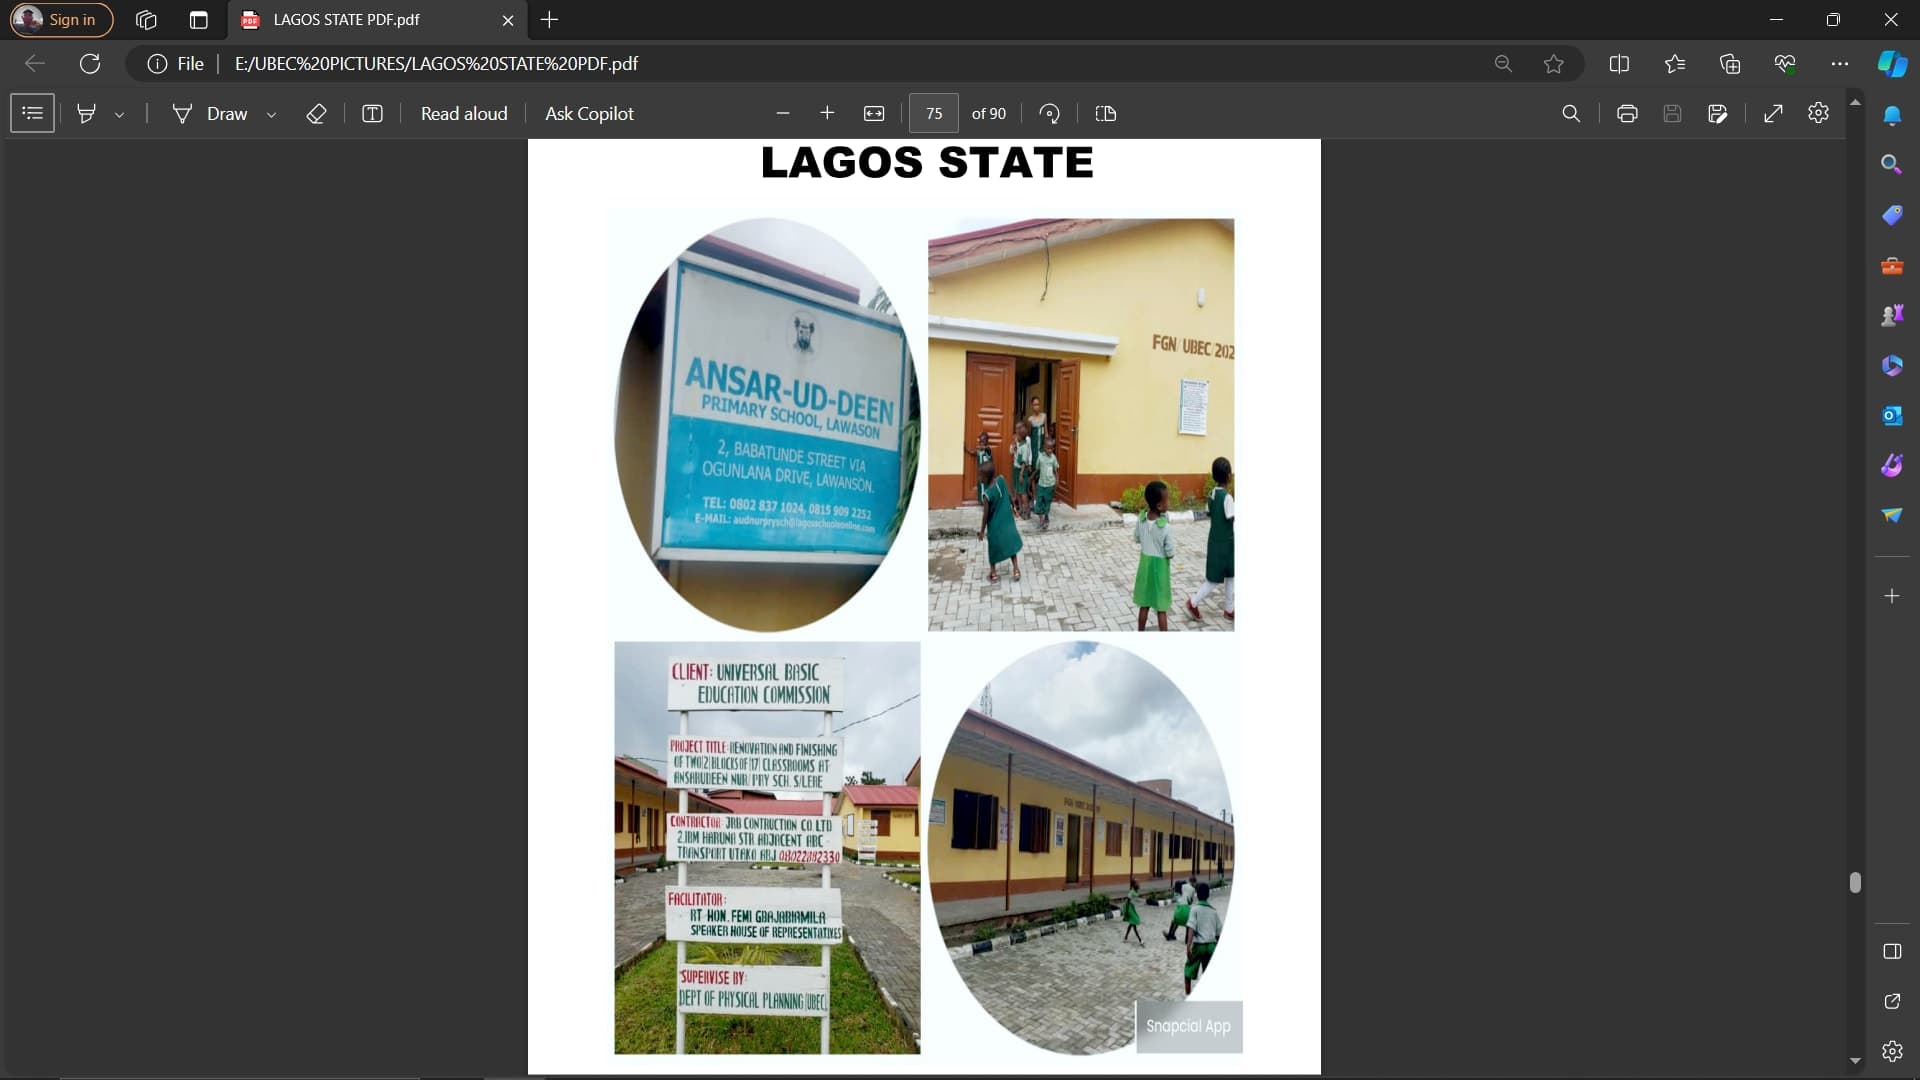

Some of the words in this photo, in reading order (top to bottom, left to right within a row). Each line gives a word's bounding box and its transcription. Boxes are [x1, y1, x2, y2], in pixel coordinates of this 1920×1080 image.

[49, 12, 77, 28] Sign
[80, 12, 96, 26] in
[273, 13, 320, 27] LAGOS
[323, 13, 363, 27] STATE
[366, 13, 421, 30] PDF.pdf
[177, 56, 205, 72] File
[235, 56, 640, 75] E:/UBEC%20PICTURES/LAGOS%20STATE%20PDF.pdf
[206, 106, 248, 122] Draw
[421, 106, 456, 121] Read
[458, 106, 509, 121] aloud
[544, 106, 572, 121] Ask
[574, 106, 635, 125] Copilot
[925, 107, 944, 121] 75
[971, 105, 987, 121] of
[988, 106, 1007, 121] 90
[762, 145, 924, 179] LAGOS
[938, 145, 1094, 179] STATE
[685, 356, 894, 427] ANSAR-UD-DEEN
[702, 394, 767, 419] PRIMARY
[770, 405, 823, 432] SCHOOL,
[826, 417, 880, 441] LAWASON
[717, 439, 729, 459] 2,
[734, 441, 804, 465] BABATUNDE
[807, 451, 847, 469] STREET
[849, 457, 866, 473] VIA
[702, 460, 772, 482] OGUNLANA
[775, 469, 813, 488] DRIVE,
[816, 473, 875, 494] LAWANSON.
[703, 496, 727, 510] TEL:
[729, 497, 756, 512] 0802
[758, 498, 777, 513] 837
[695, 513, 732, 525] E-MAIL:
[672, 662, 713, 681] CLIENT:
[716, 663, 780, 682] UNIVERSAL
[784, 663, 820, 682] BASIC
[698, 684, 759, 704] EDUCATION
[763, 684, 831, 705] COMMISSION
[670, 739, 704, 754] PROJECT
[729, 741, 777, 756] RENOVATION
[778, 743, 794, 756] AND
[795, 743, 838, 757] FINISHING
[673, 755, 683, 768] OF
[762, 758, 815, 773] CLASSROOMS
[817, 759, 830, 774] AT
[673, 771, 728, 785] ANSARUDEEN
[743, 817, 798, 831] CONTRUCTION
[815, 819, 833, 832] LTD
[702, 831, 736, 846] HARUNA
[757, 833, 803, 847] ADJACENT
[805, 834, 824, 848] ABC
[677, 845, 727, 860] TRANSPORT
[728, 848, 758, 861] UTAKO
[759, 849, 777, 862] ABJ
[668, 891, 727, 906] FACILITATOR:
[690, 908, 703, 922] RT
[731, 909, 753, 923] FEMI
[754, 910, 826, 925] GBAJABIAMILA
[690, 924, 730, 937] SPEAKER
[730, 925, 758, 938] HOUSE
[759, 926, 770, 938] OF
[771, 926, 843, 940] REPRESENTATIVES
[680, 969, 730, 985] SUPERVISE
[679, 988, 702, 1007] DEPT
[704, 990, 716, 1007] OF
[718, 991, 760, 1009] PHYSICAL
[762, 991, 804, 1010] PLANNING
